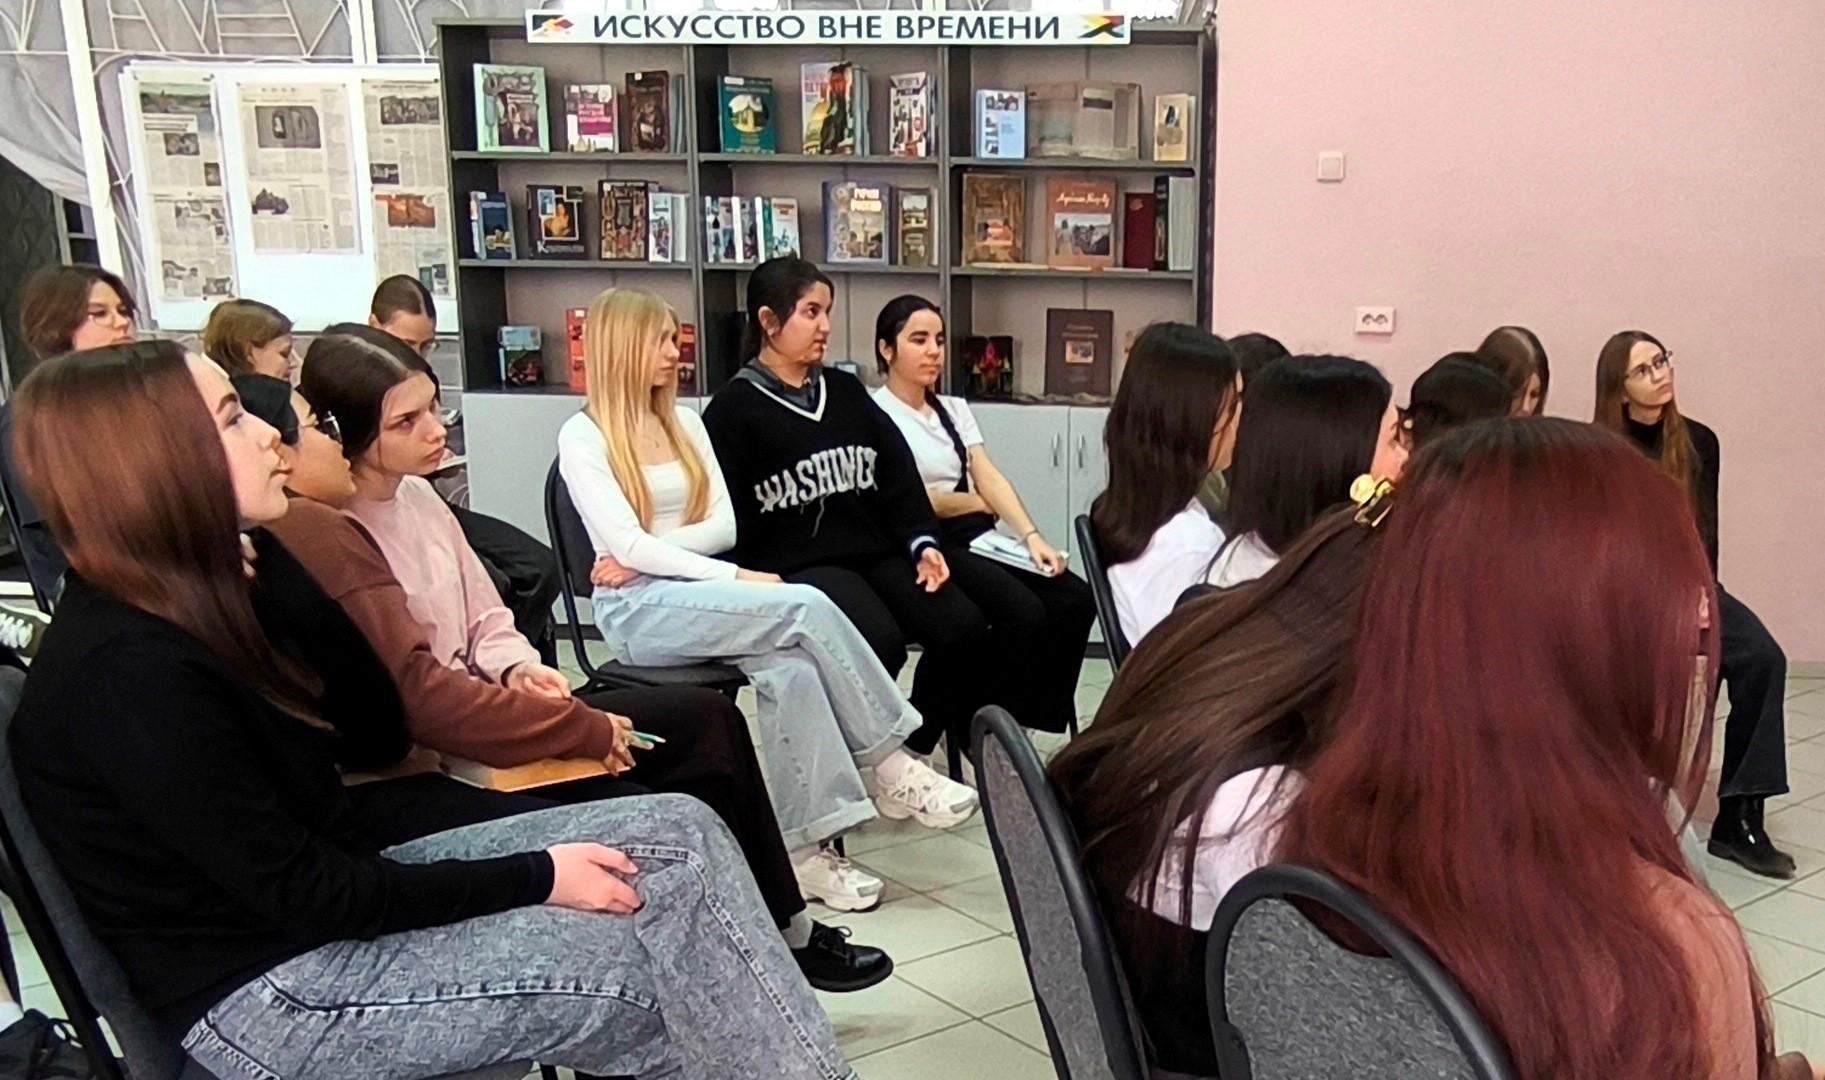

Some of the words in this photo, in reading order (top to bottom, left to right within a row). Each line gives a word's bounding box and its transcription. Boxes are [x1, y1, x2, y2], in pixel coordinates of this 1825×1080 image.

[593, 14, 805, 39] ИСКУССТВО
[818, 15, 881, 39] ВНЕ
[896, 16, 1059, 39] ВРЕМЕНИ
